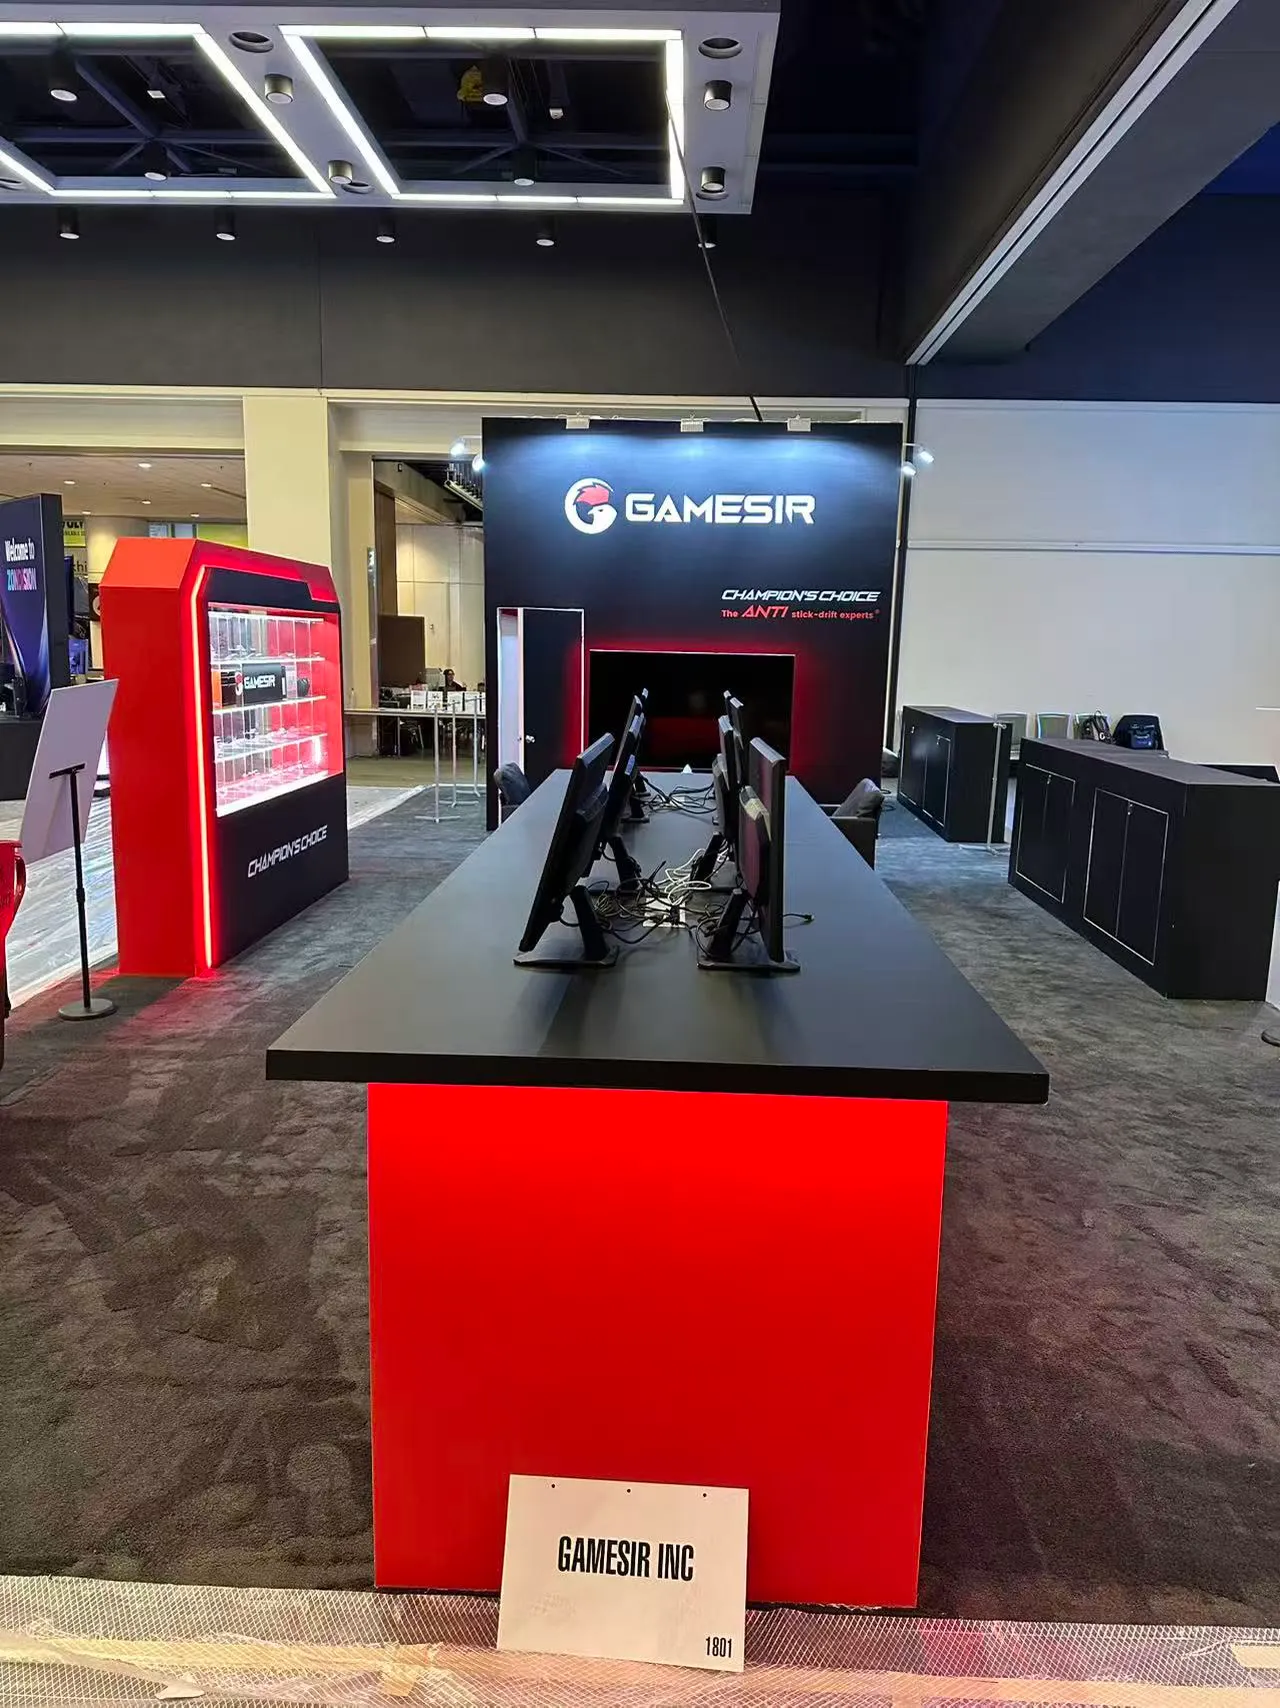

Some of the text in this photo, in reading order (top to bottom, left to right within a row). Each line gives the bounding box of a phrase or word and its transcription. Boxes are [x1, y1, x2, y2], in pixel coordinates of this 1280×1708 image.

[625, 492, 816, 525] GAMESIR
[4, 537, 35, 562] Welcome to
[721, 589, 881, 602] CHAMPION'S CHOICE
[721, 604, 874, 621] The ANTI stick-drift experts
[243, 674, 276, 690] GAMESIR
[247, 824, 328, 878] CHAMPION'S CHOICE
[557, 1535, 695, 1582] GAMESIR INC
[705, 1636, 733, 1659] 1801
